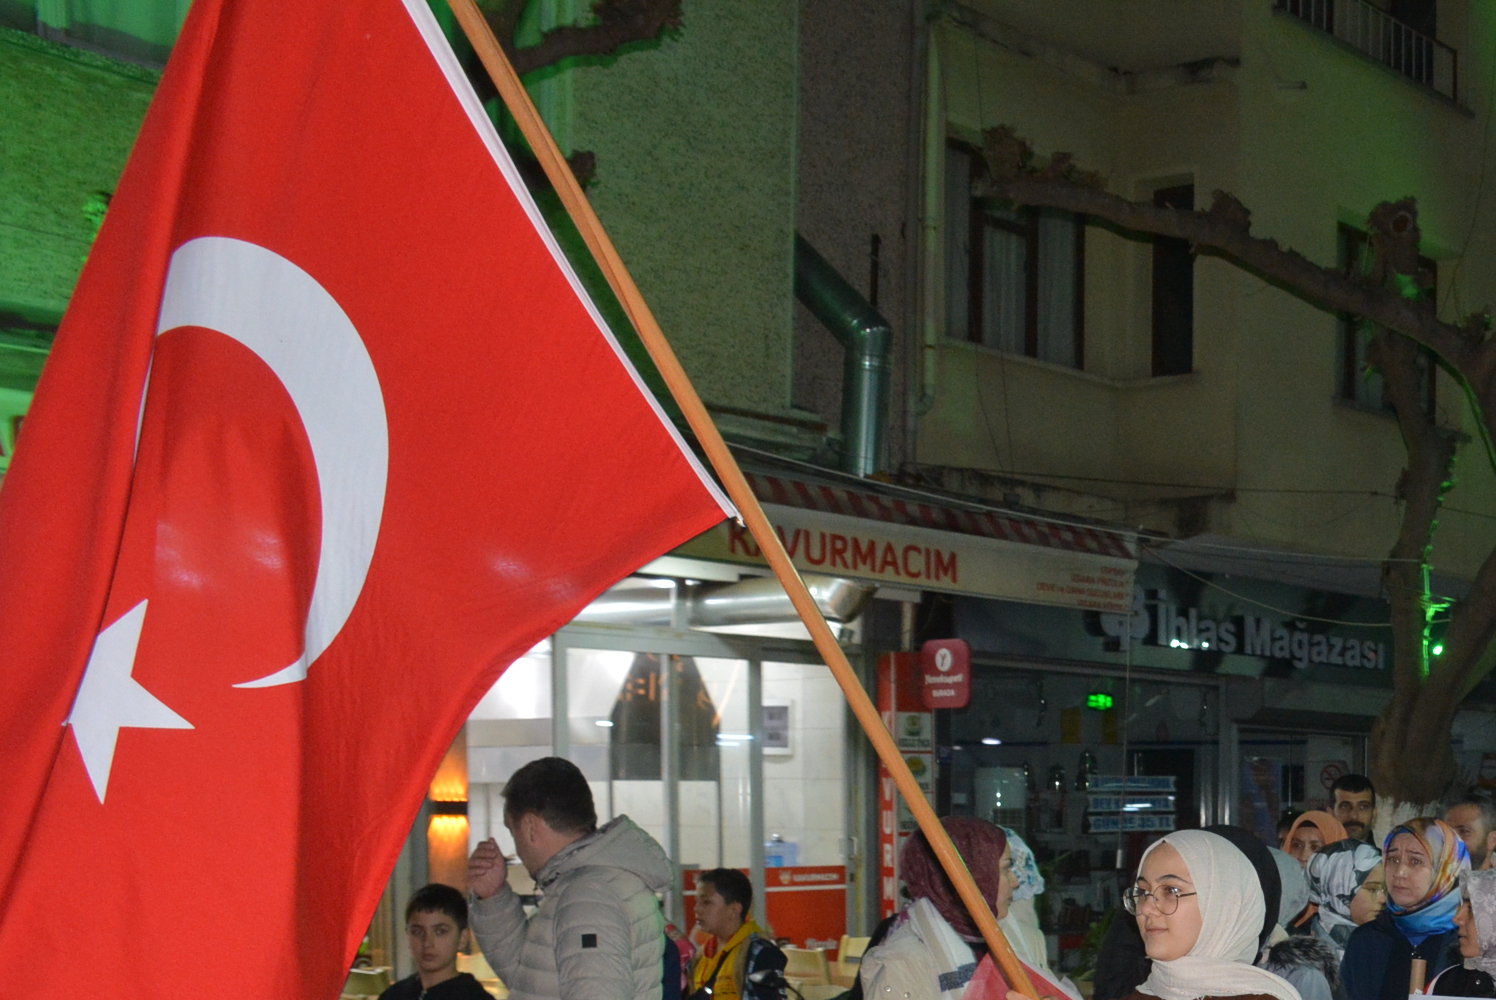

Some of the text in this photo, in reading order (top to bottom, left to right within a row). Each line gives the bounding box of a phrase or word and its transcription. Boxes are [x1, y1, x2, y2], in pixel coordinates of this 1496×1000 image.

[727, 521, 959, 584] KVURMACIM
[1157, 589, 1385, 668] İhlas Mağazası
